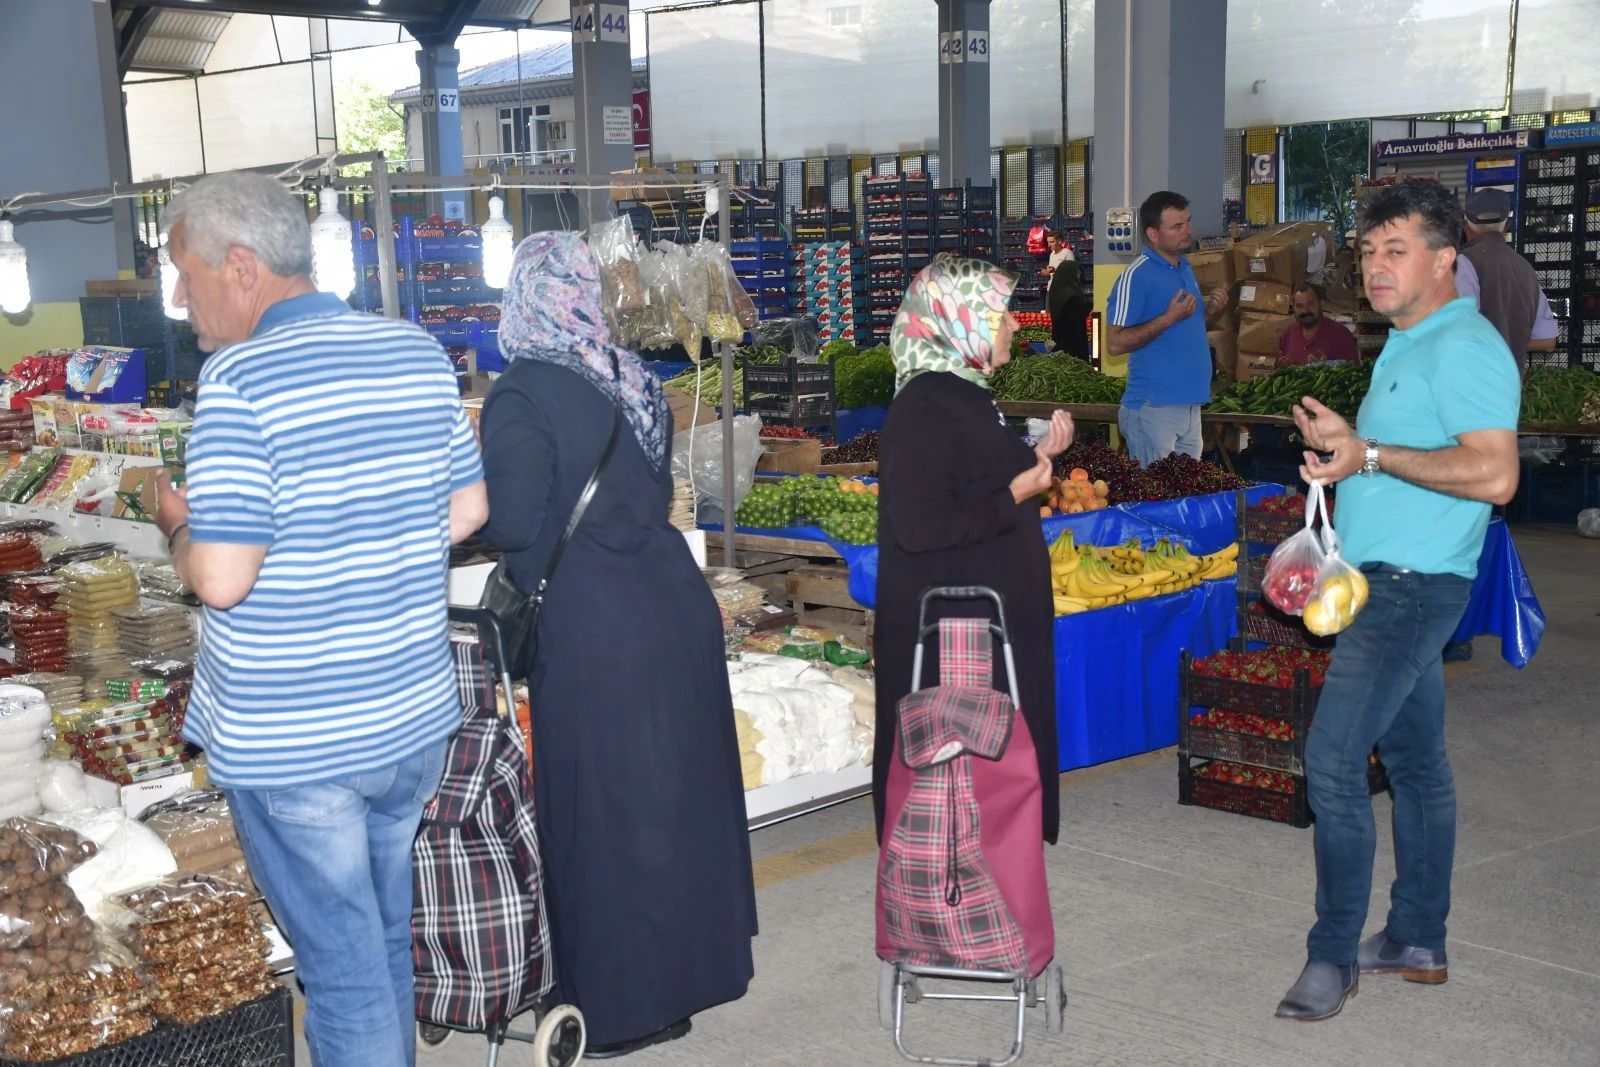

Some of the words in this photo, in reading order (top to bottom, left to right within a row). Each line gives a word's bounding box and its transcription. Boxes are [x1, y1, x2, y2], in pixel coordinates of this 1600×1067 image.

[574, 13, 593, 34] 44
[602, 13, 627, 33] 44
[942, 39, 961, 55] 43
[969, 39, 987, 54] 43
[422, 94, 435, 107] 67
[440, 94, 457, 107] 67
[1384, 139, 1454, 155] Arnavutoğlu
[1457, 135, 1513, 153] Balıkçılık
[1254, 154, 1271, 176] G
